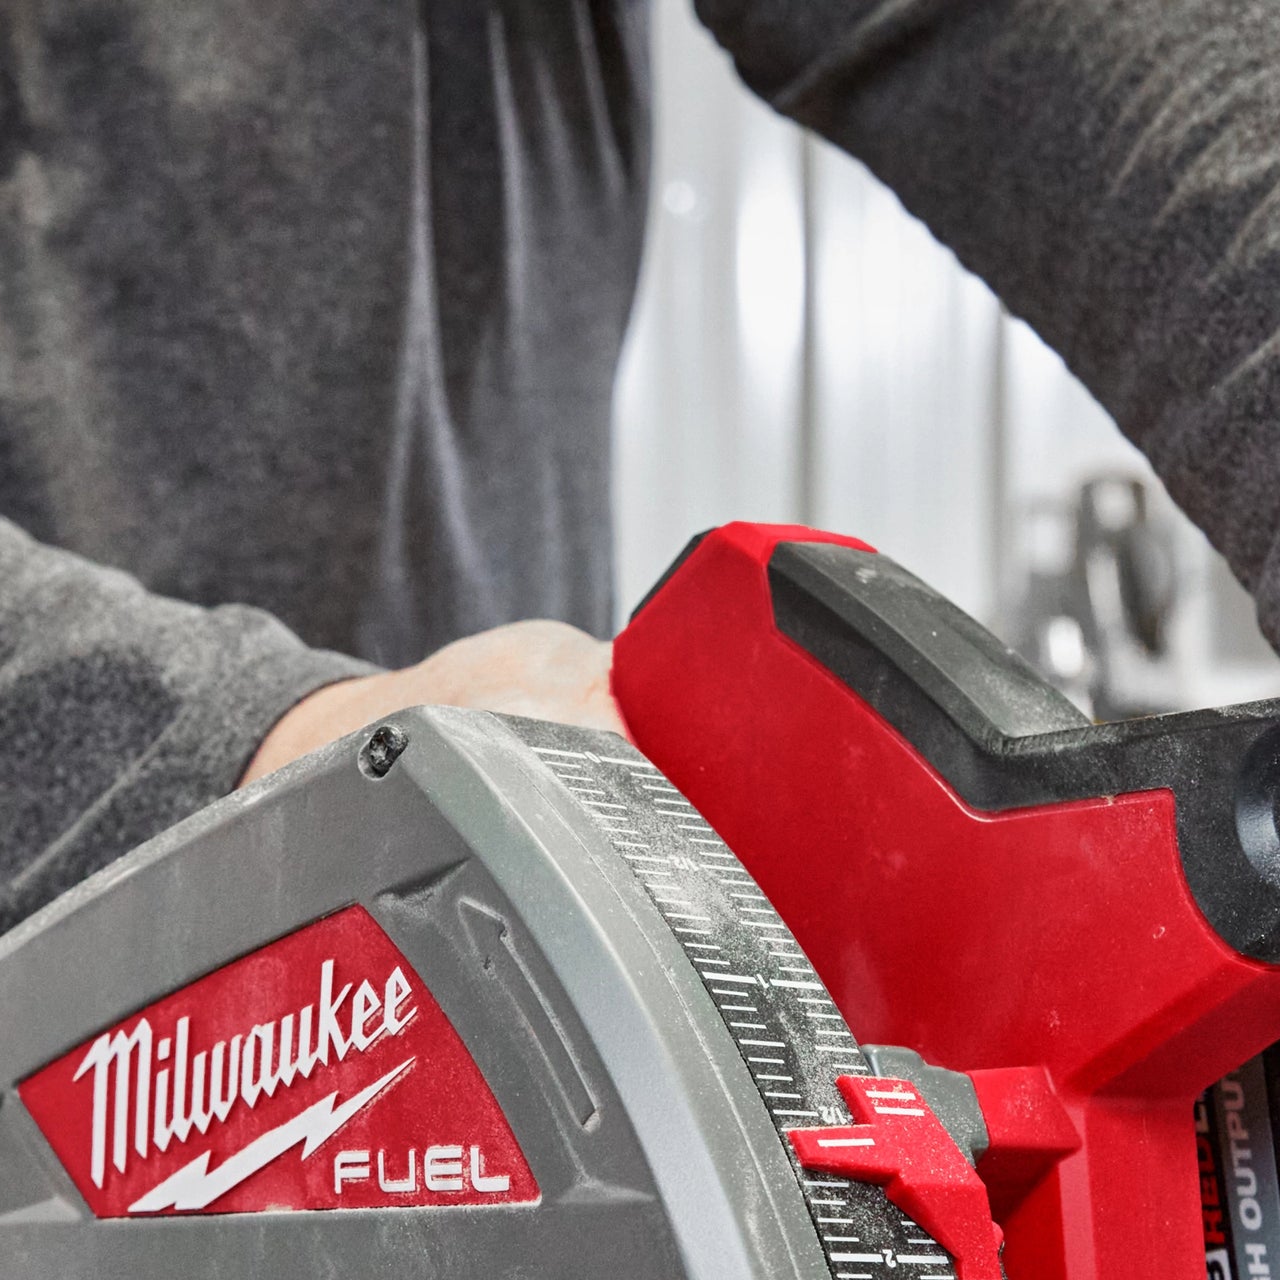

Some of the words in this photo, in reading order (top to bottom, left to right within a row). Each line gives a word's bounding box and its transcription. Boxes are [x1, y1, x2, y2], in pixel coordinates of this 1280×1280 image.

[73, 959, 418, 1190] Milwaukee
[333, 1144, 511, 1195] FUEL
[1221, 1071, 1264, 1231] OUTPU
[881, 1249, 897, 1268] 2
